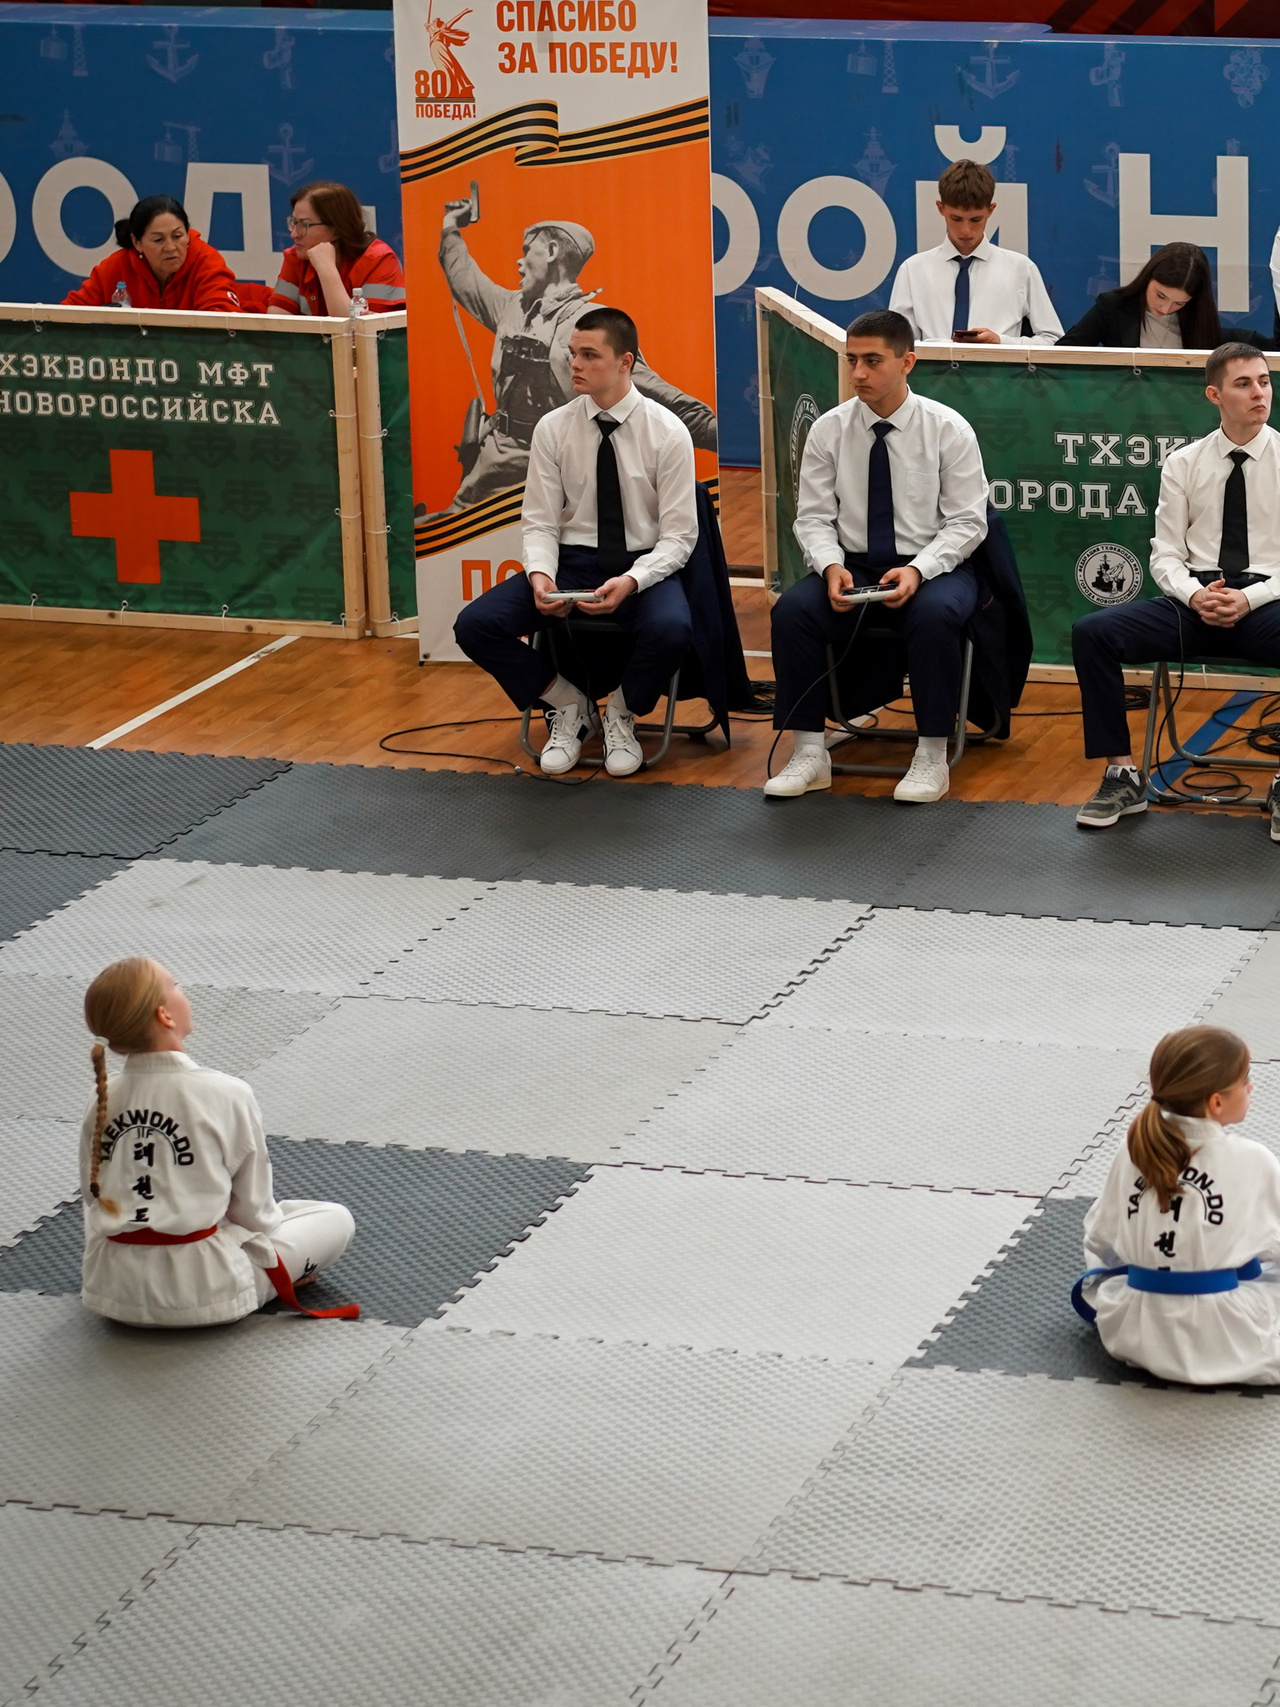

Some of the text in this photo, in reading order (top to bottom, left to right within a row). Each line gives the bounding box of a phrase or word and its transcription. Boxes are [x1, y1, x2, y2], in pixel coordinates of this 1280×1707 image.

[496, 0, 637, 32] СПАСИБО
[498, 42, 678, 78] ЗА ПОБЕДУ!
[414, 70, 447, 98] 80
[415, 104, 477, 120] ПОБЕДА!
[198, 361, 274, 388] МФТ
[1054, 432, 1202, 467] ТХЭК
[1127, 1166, 1224, 1226] TAEON-DO
